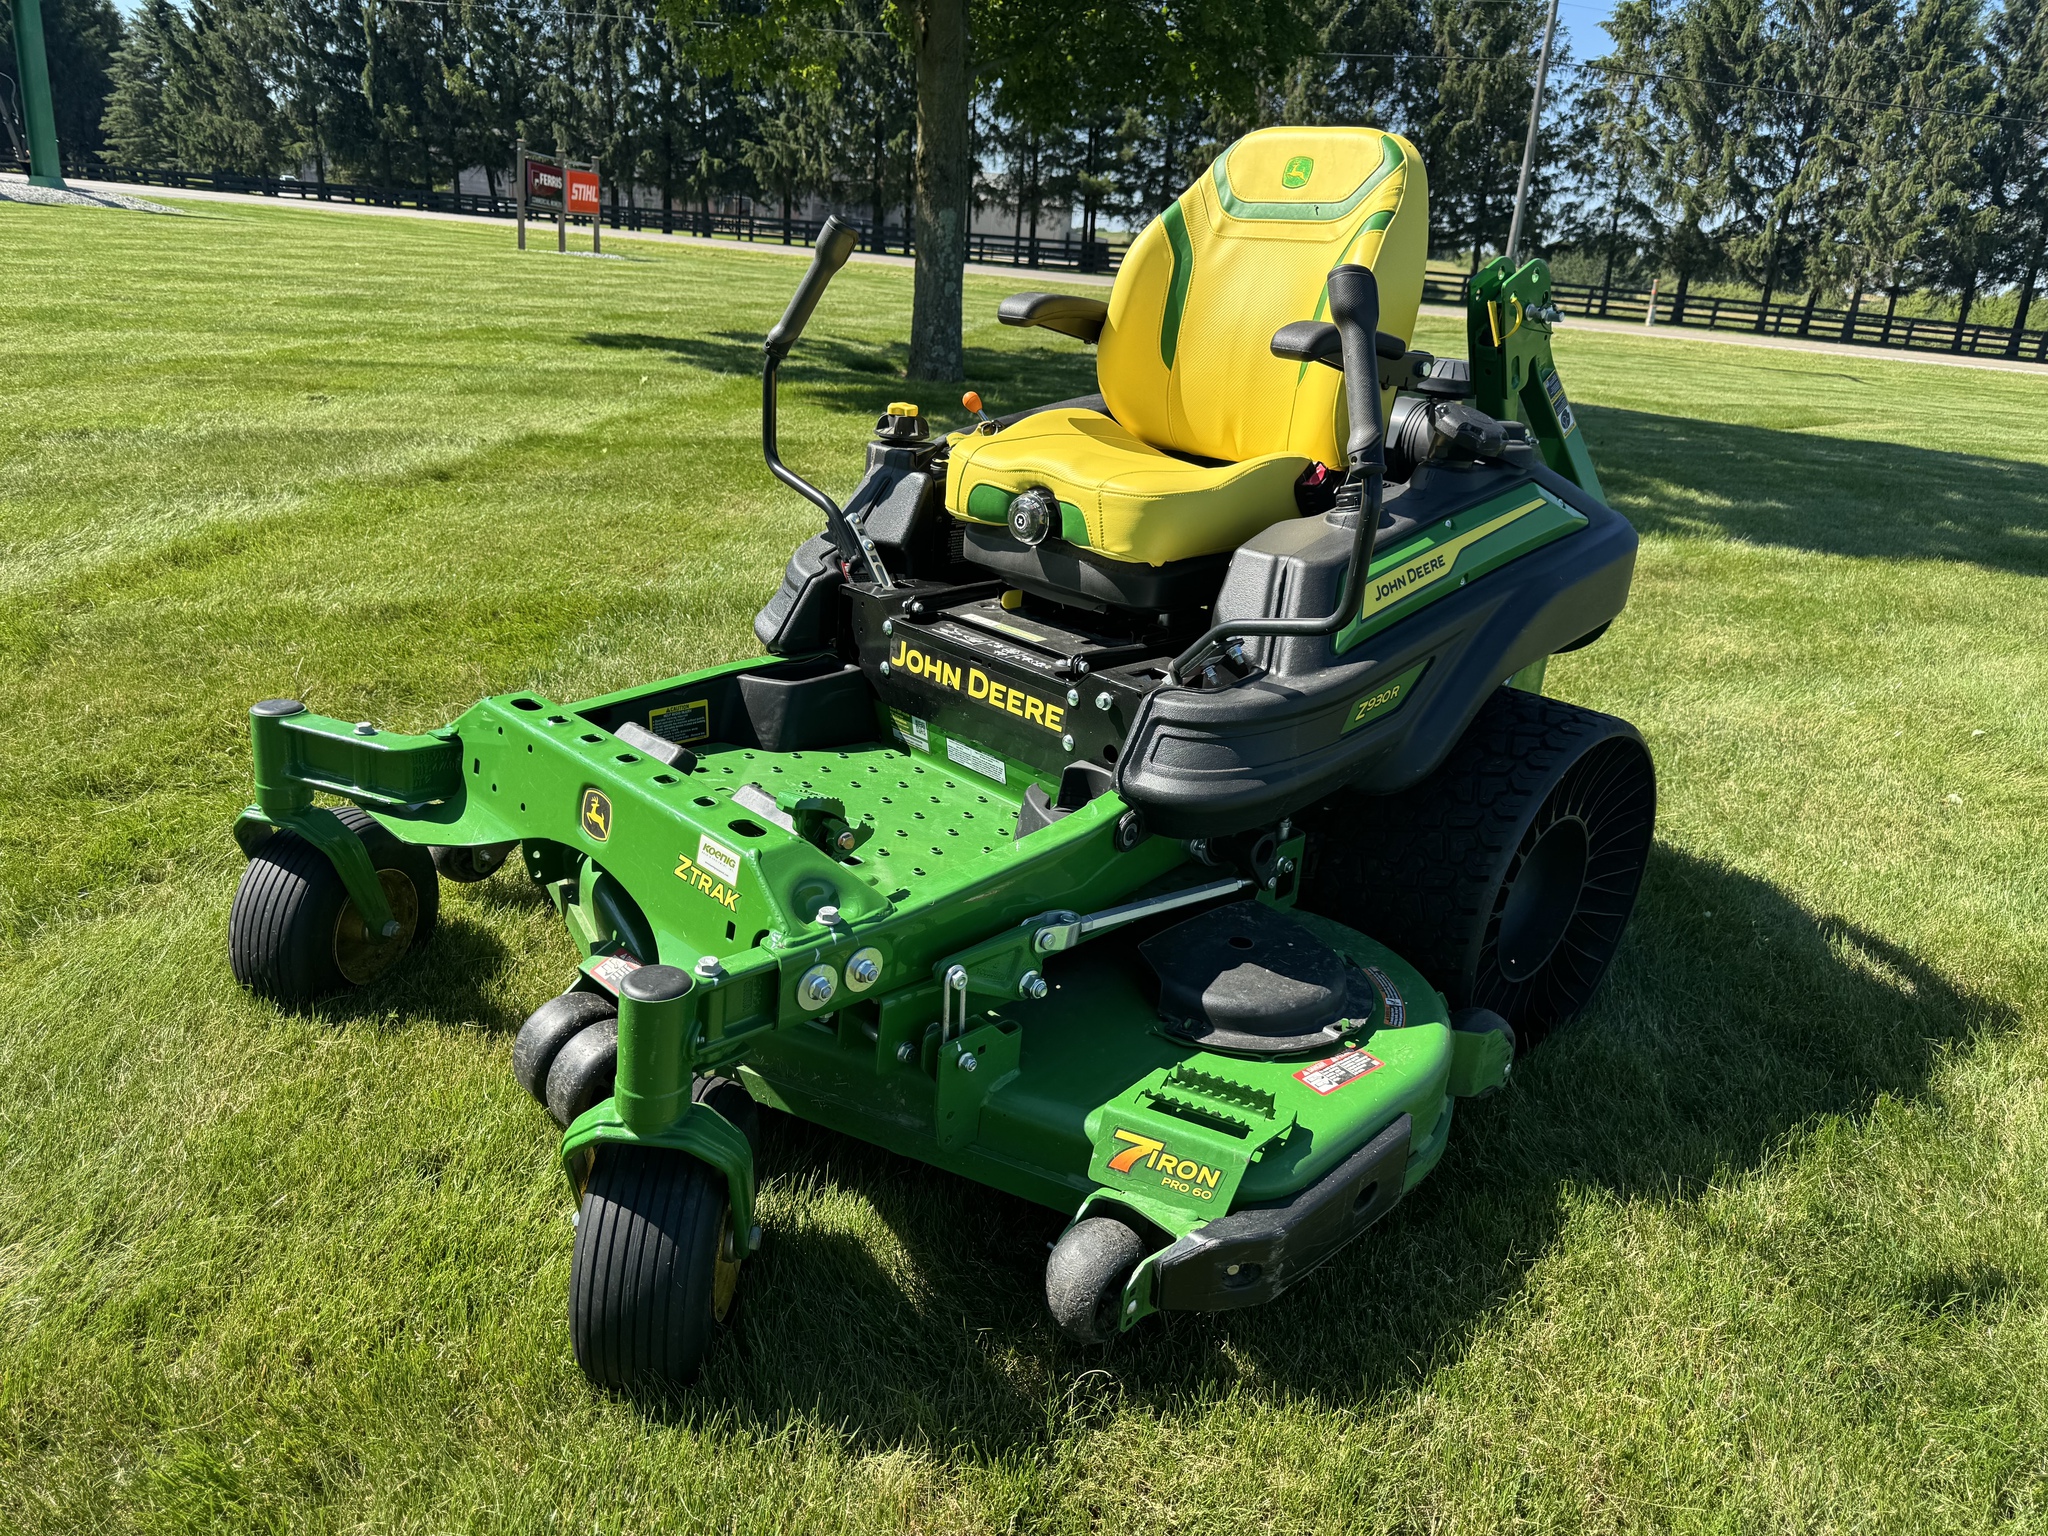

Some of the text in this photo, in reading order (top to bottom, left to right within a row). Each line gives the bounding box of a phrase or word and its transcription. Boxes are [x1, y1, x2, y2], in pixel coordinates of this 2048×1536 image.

[540, 173, 562, 189] FERRIS
[571, 183, 598, 202] STIHL
[1375, 554, 1446, 601] JOHN DEERE
[891, 641, 962, 691] JOHN
[967, 667, 1065, 733] DEERE
[1355, 685, 1400, 721] Z930R
[673, 853, 742, 914] ZTRAK
[1160, 1176, 1213, 1201] PRO 60
